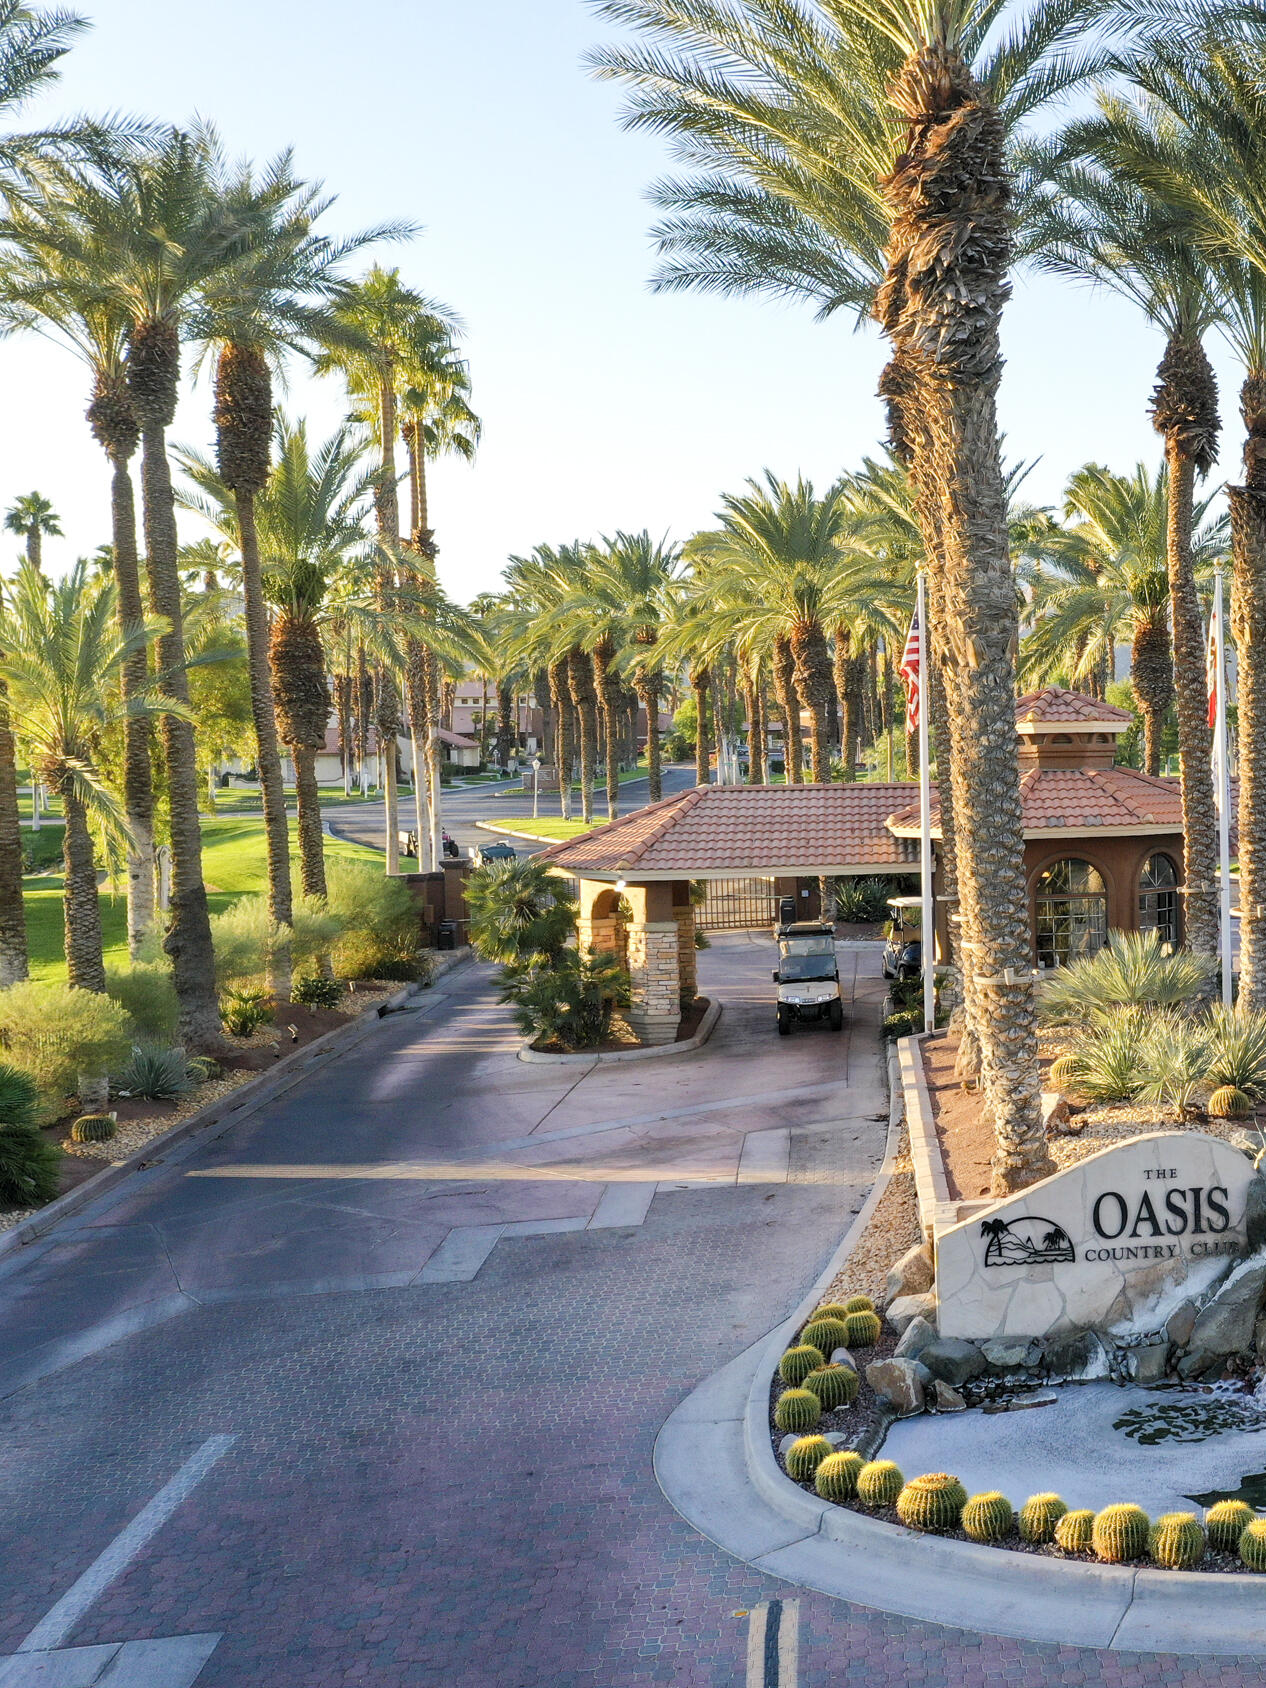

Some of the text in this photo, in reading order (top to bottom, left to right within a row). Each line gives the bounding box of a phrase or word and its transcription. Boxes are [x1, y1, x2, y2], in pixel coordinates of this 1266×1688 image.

[1144, 1168, 1177, 1180] THE
[1093, 1186, 1230, 1239] OASIS
[1085, 1244, 1177, 1261] COUNTRY
